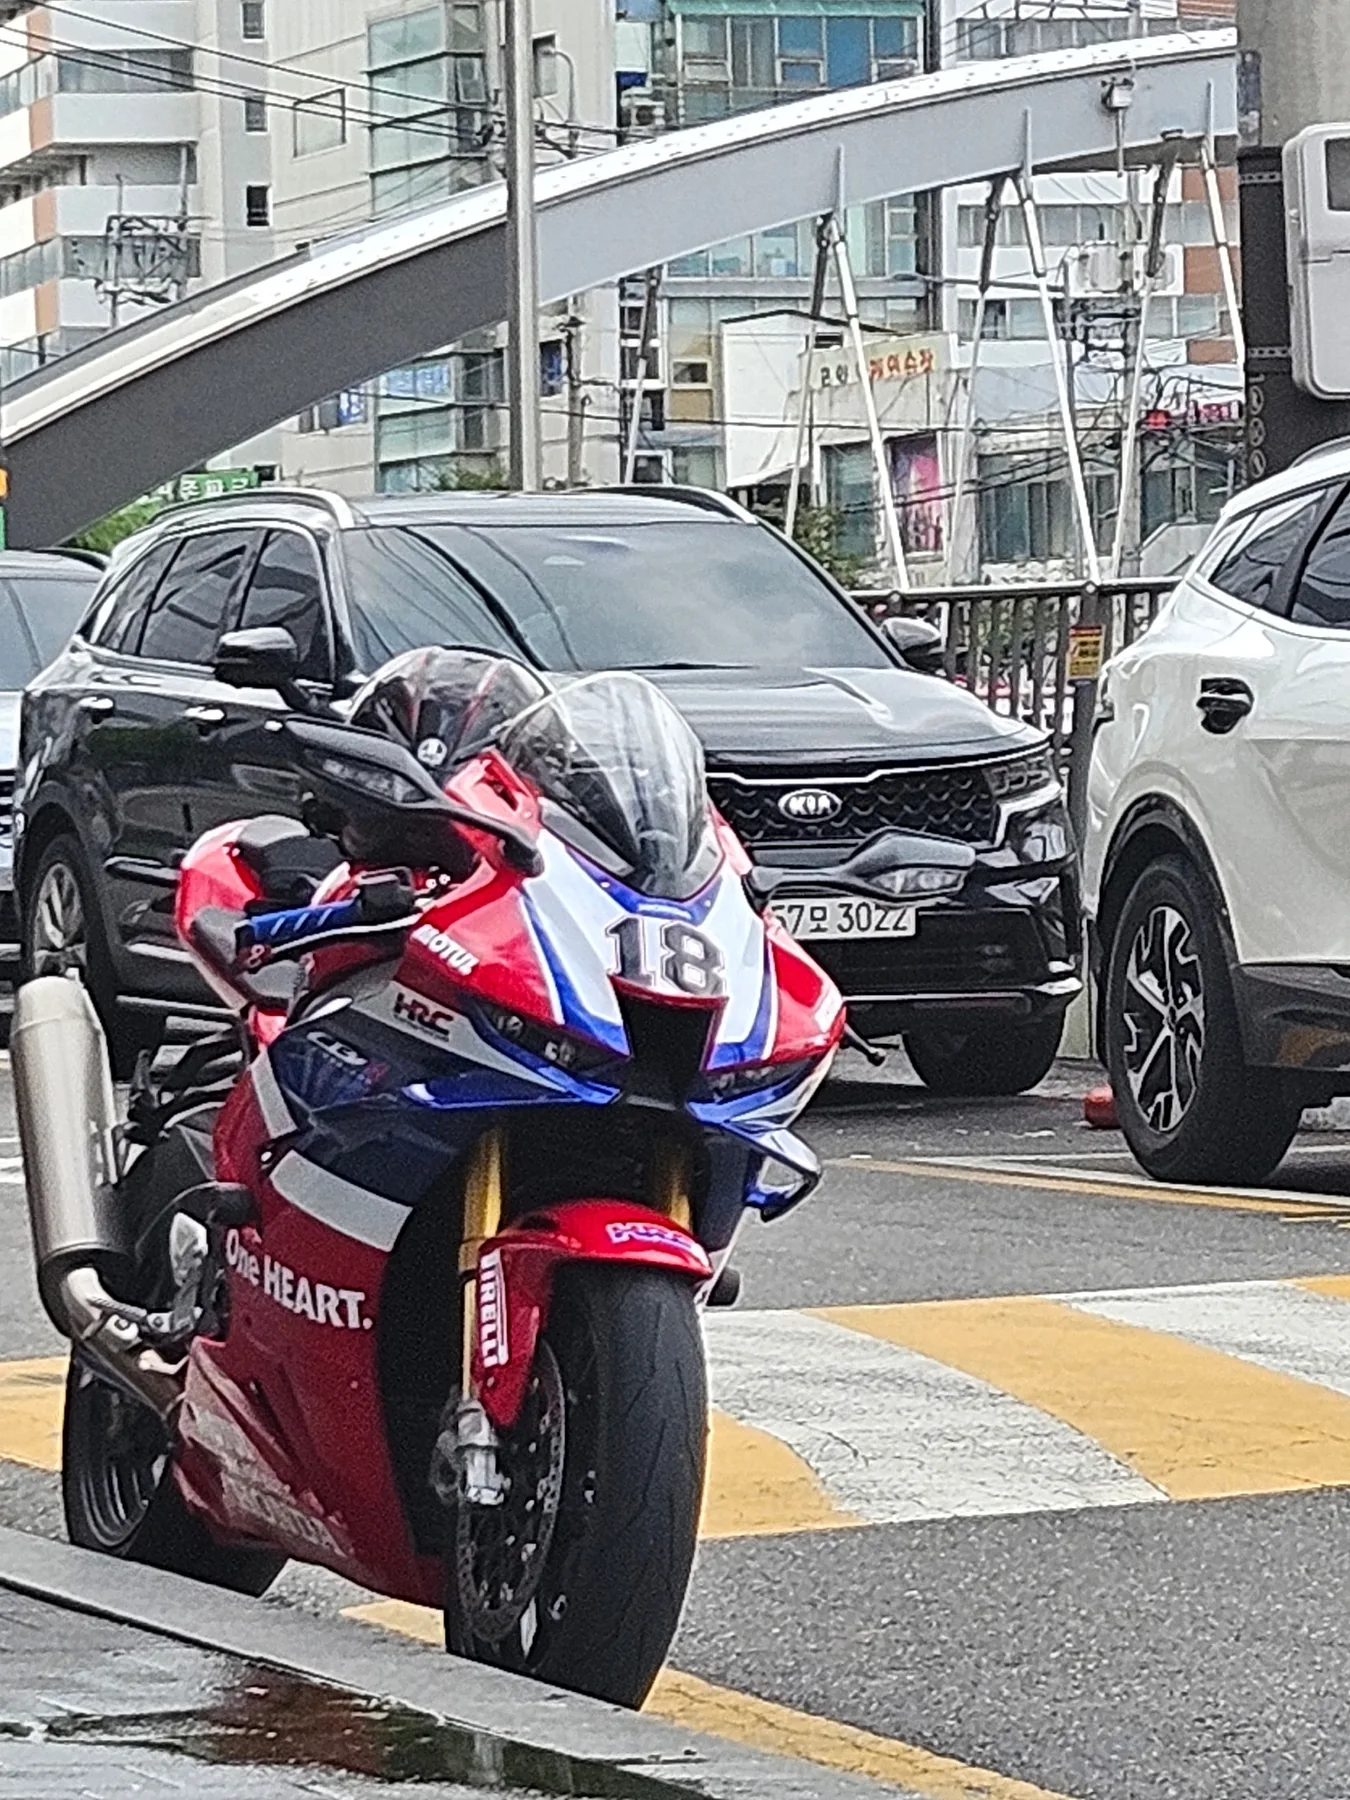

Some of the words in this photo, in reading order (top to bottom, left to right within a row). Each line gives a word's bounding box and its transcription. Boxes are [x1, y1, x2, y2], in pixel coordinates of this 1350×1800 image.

[786, 792, 836, 818] KIA
[837, 902, 908, 932] 3022
[604, 915, 727, 996] 18
[393, 992, 454, 1036] HRC
[225, 1228, 261, 1286] One
[263, 1254, 373, 1330] HEART.
